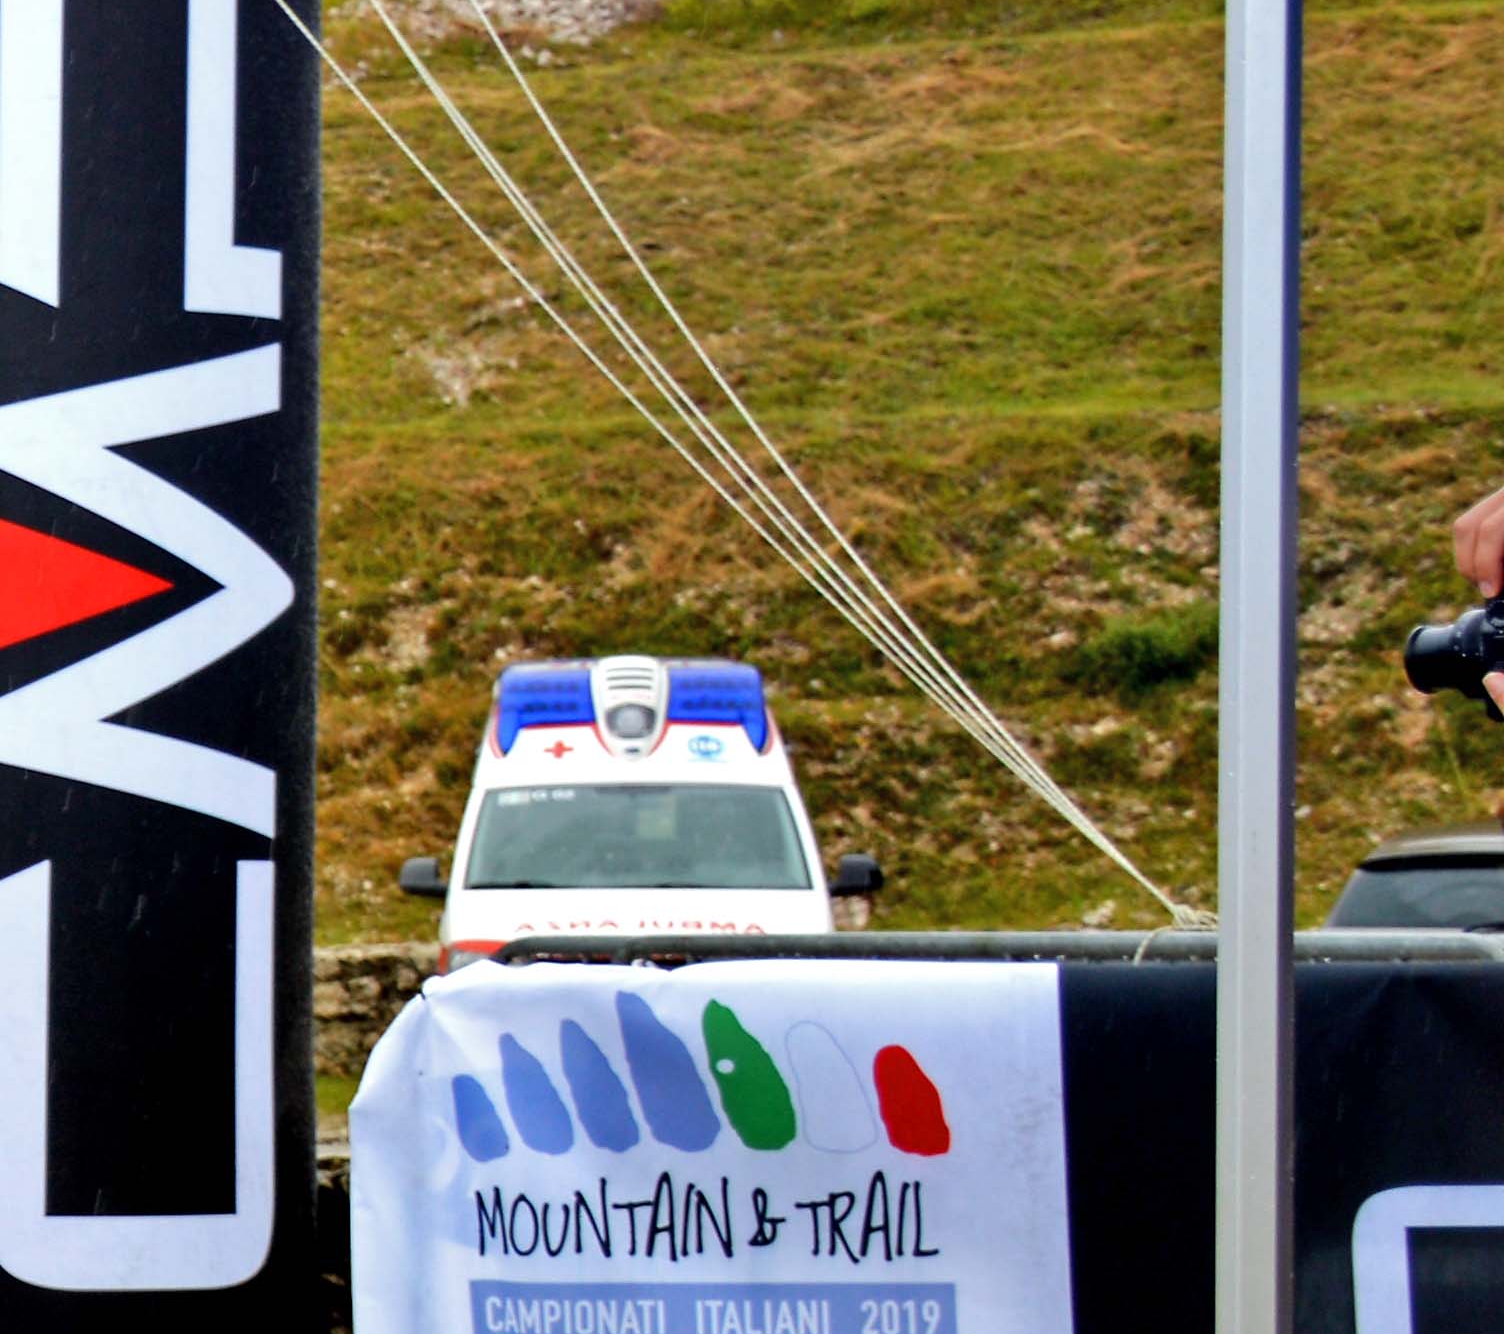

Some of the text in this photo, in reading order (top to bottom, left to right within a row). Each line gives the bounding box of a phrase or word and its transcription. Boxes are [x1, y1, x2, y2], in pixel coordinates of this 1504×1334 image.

[474, 1169, 940, 1264] MOUNTAIN & TRAIL
